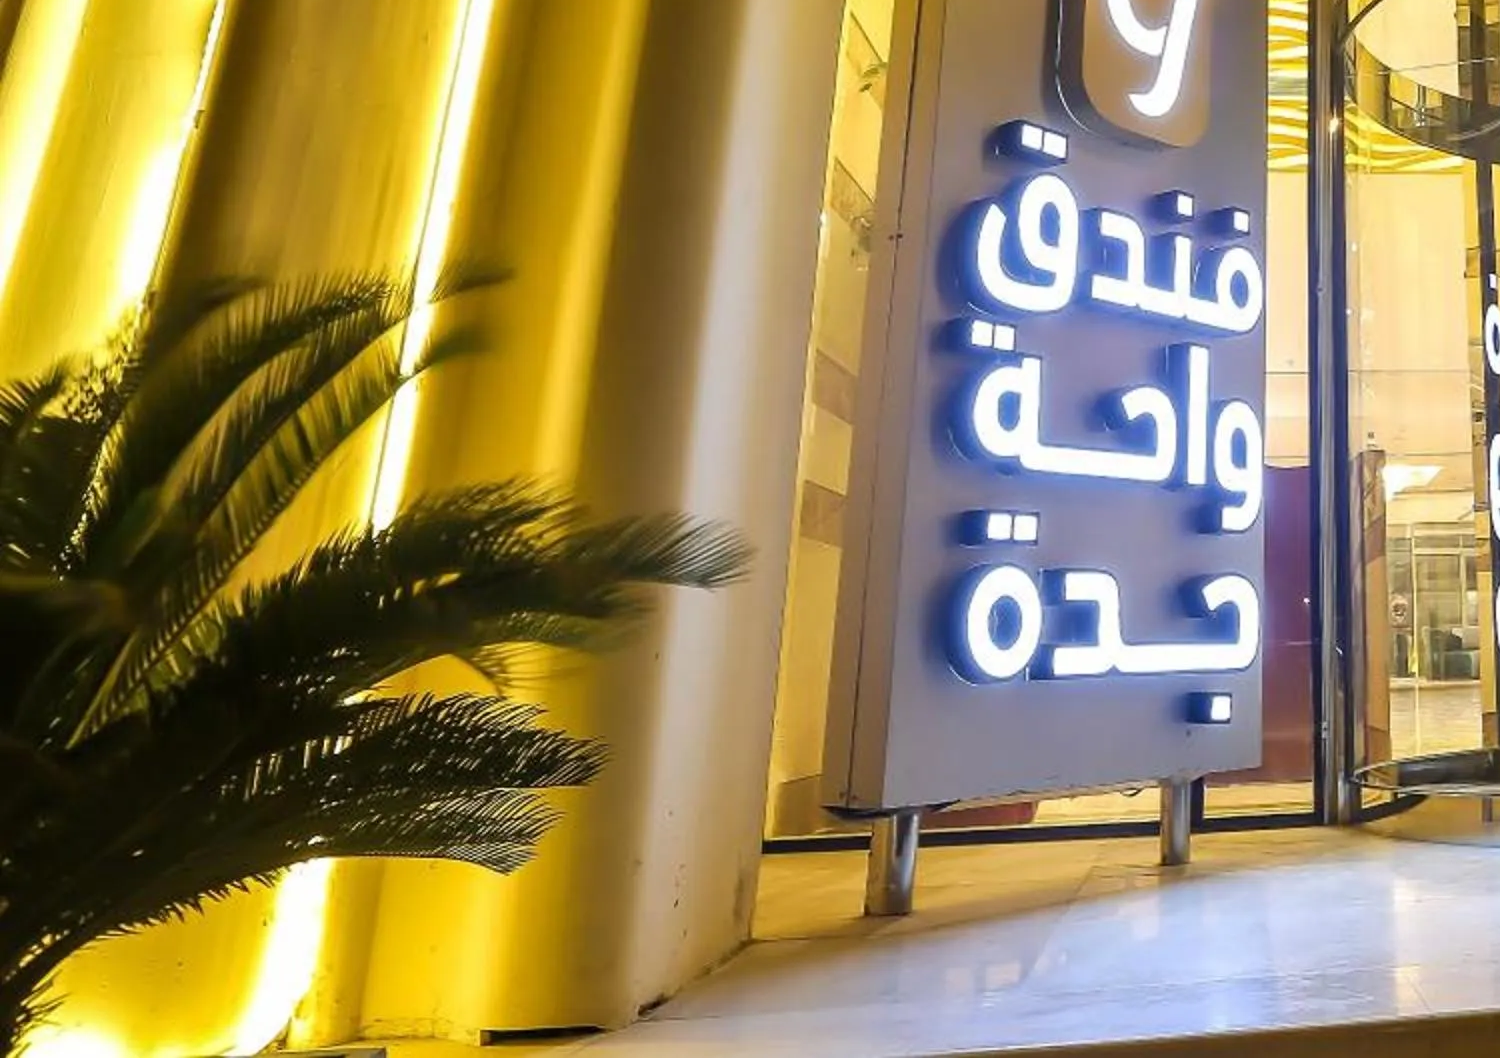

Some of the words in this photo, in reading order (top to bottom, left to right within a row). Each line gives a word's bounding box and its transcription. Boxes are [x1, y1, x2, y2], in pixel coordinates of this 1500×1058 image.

[976, 124, 1264, 332] فندق
[971, 320, 1263, 531] واحة
[966, 514, 1260, 720] جدة
